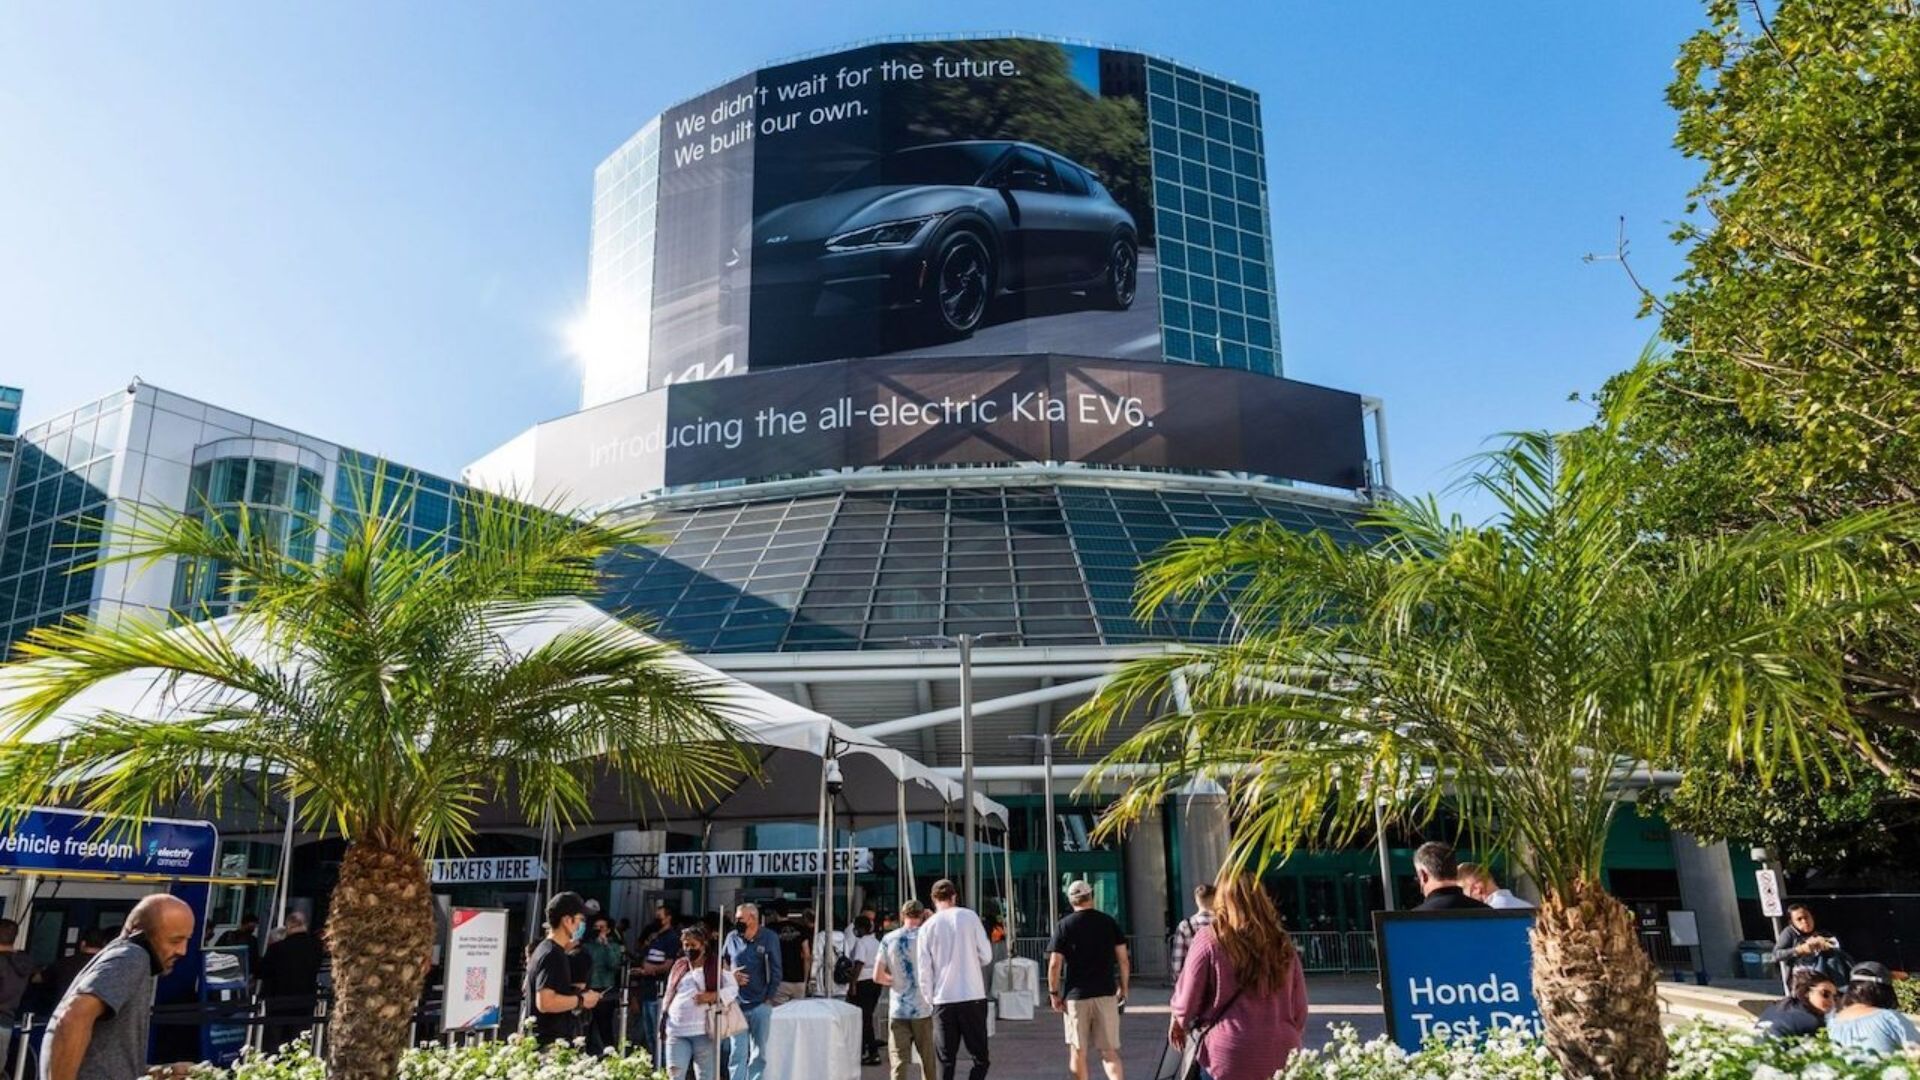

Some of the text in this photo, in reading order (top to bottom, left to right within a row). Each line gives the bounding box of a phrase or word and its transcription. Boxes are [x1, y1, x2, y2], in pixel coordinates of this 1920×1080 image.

[676, 56, 1021, 139] We didn't wait for the future.
[674, 100, 868, 169] We built our own.
[589, 392, 1154, 469] Introducing the all-electric Kia EV6.
[0, 833, 133, 859] vehicle freedom
[157, 847, 194, 859] electrify
[438, 859, 531, 880] TICKETS HERE
[667, 855, 711, 875] ENTER
[716, 853, 754, 874] WITH
[758, 852, 817, 873] TICKETS
[1409, 973, 1519, 1005] Honda
[1411, 1010, 1541, 1043] Test Dri
